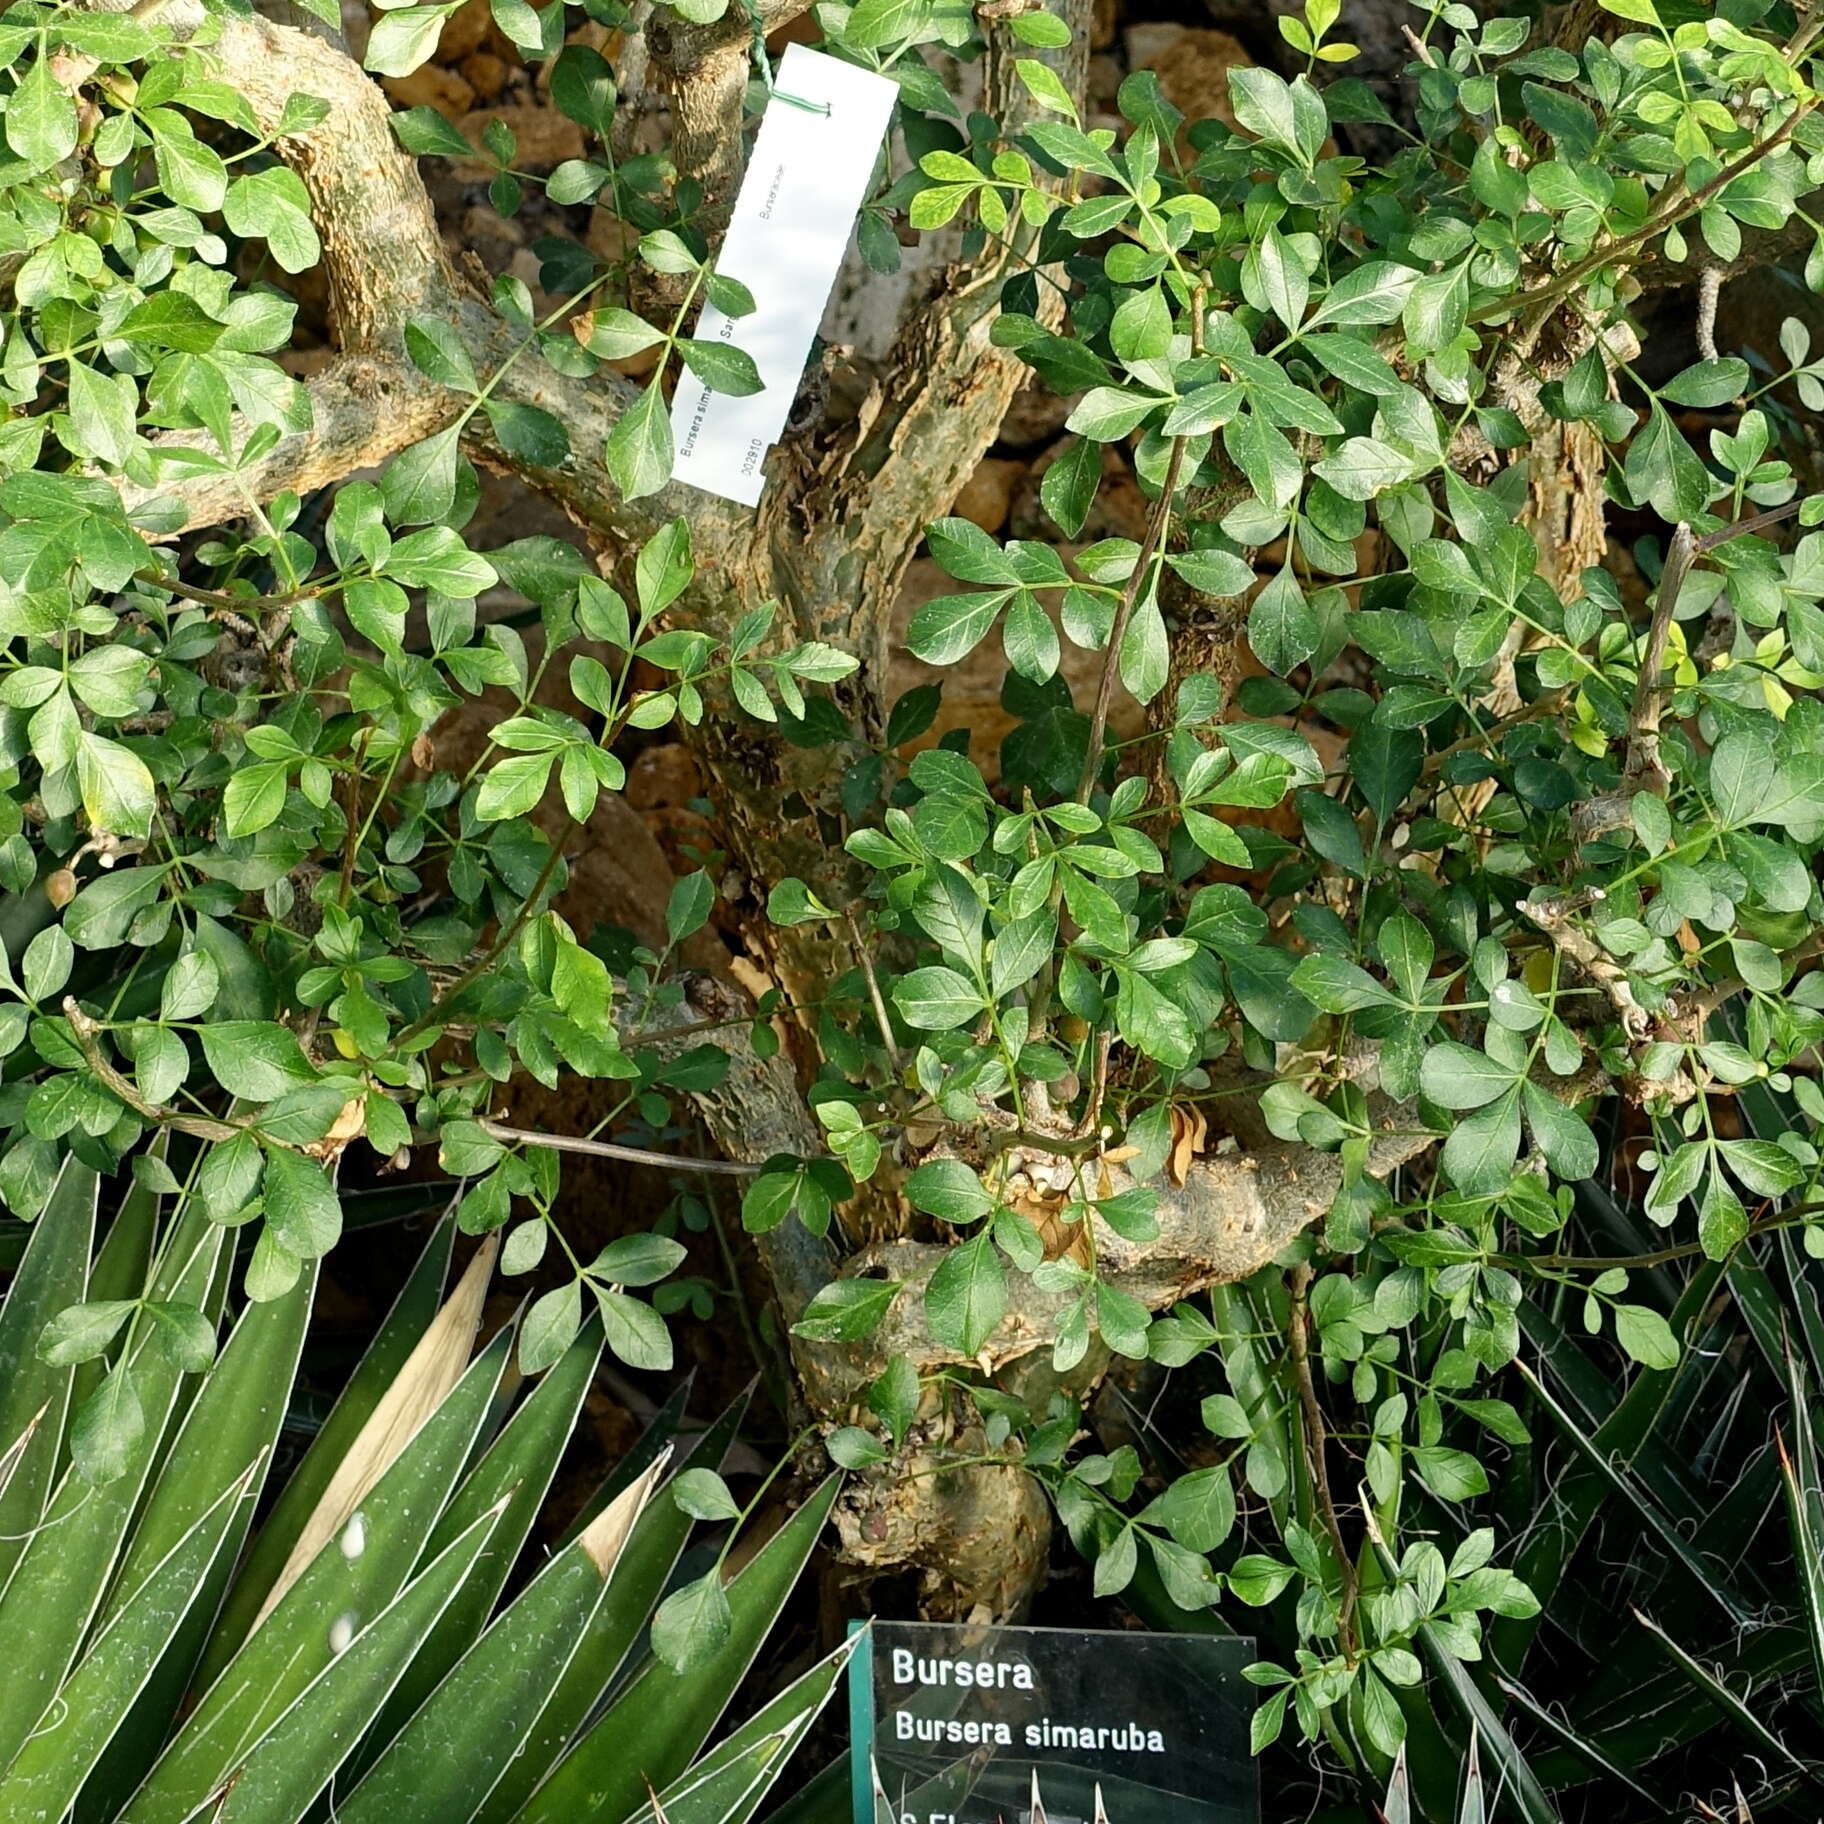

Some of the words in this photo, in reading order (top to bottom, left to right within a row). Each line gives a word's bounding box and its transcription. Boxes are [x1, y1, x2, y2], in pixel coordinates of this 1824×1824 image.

[680, 415, 703, 458] Bursera
[696, 384, 712, 413] sima
[892, 1648, 1034, 1690] Bursera
[895, 1710, 1013, 1746] Bursera
[1025, 1717, 1166, 1753] simaruba
